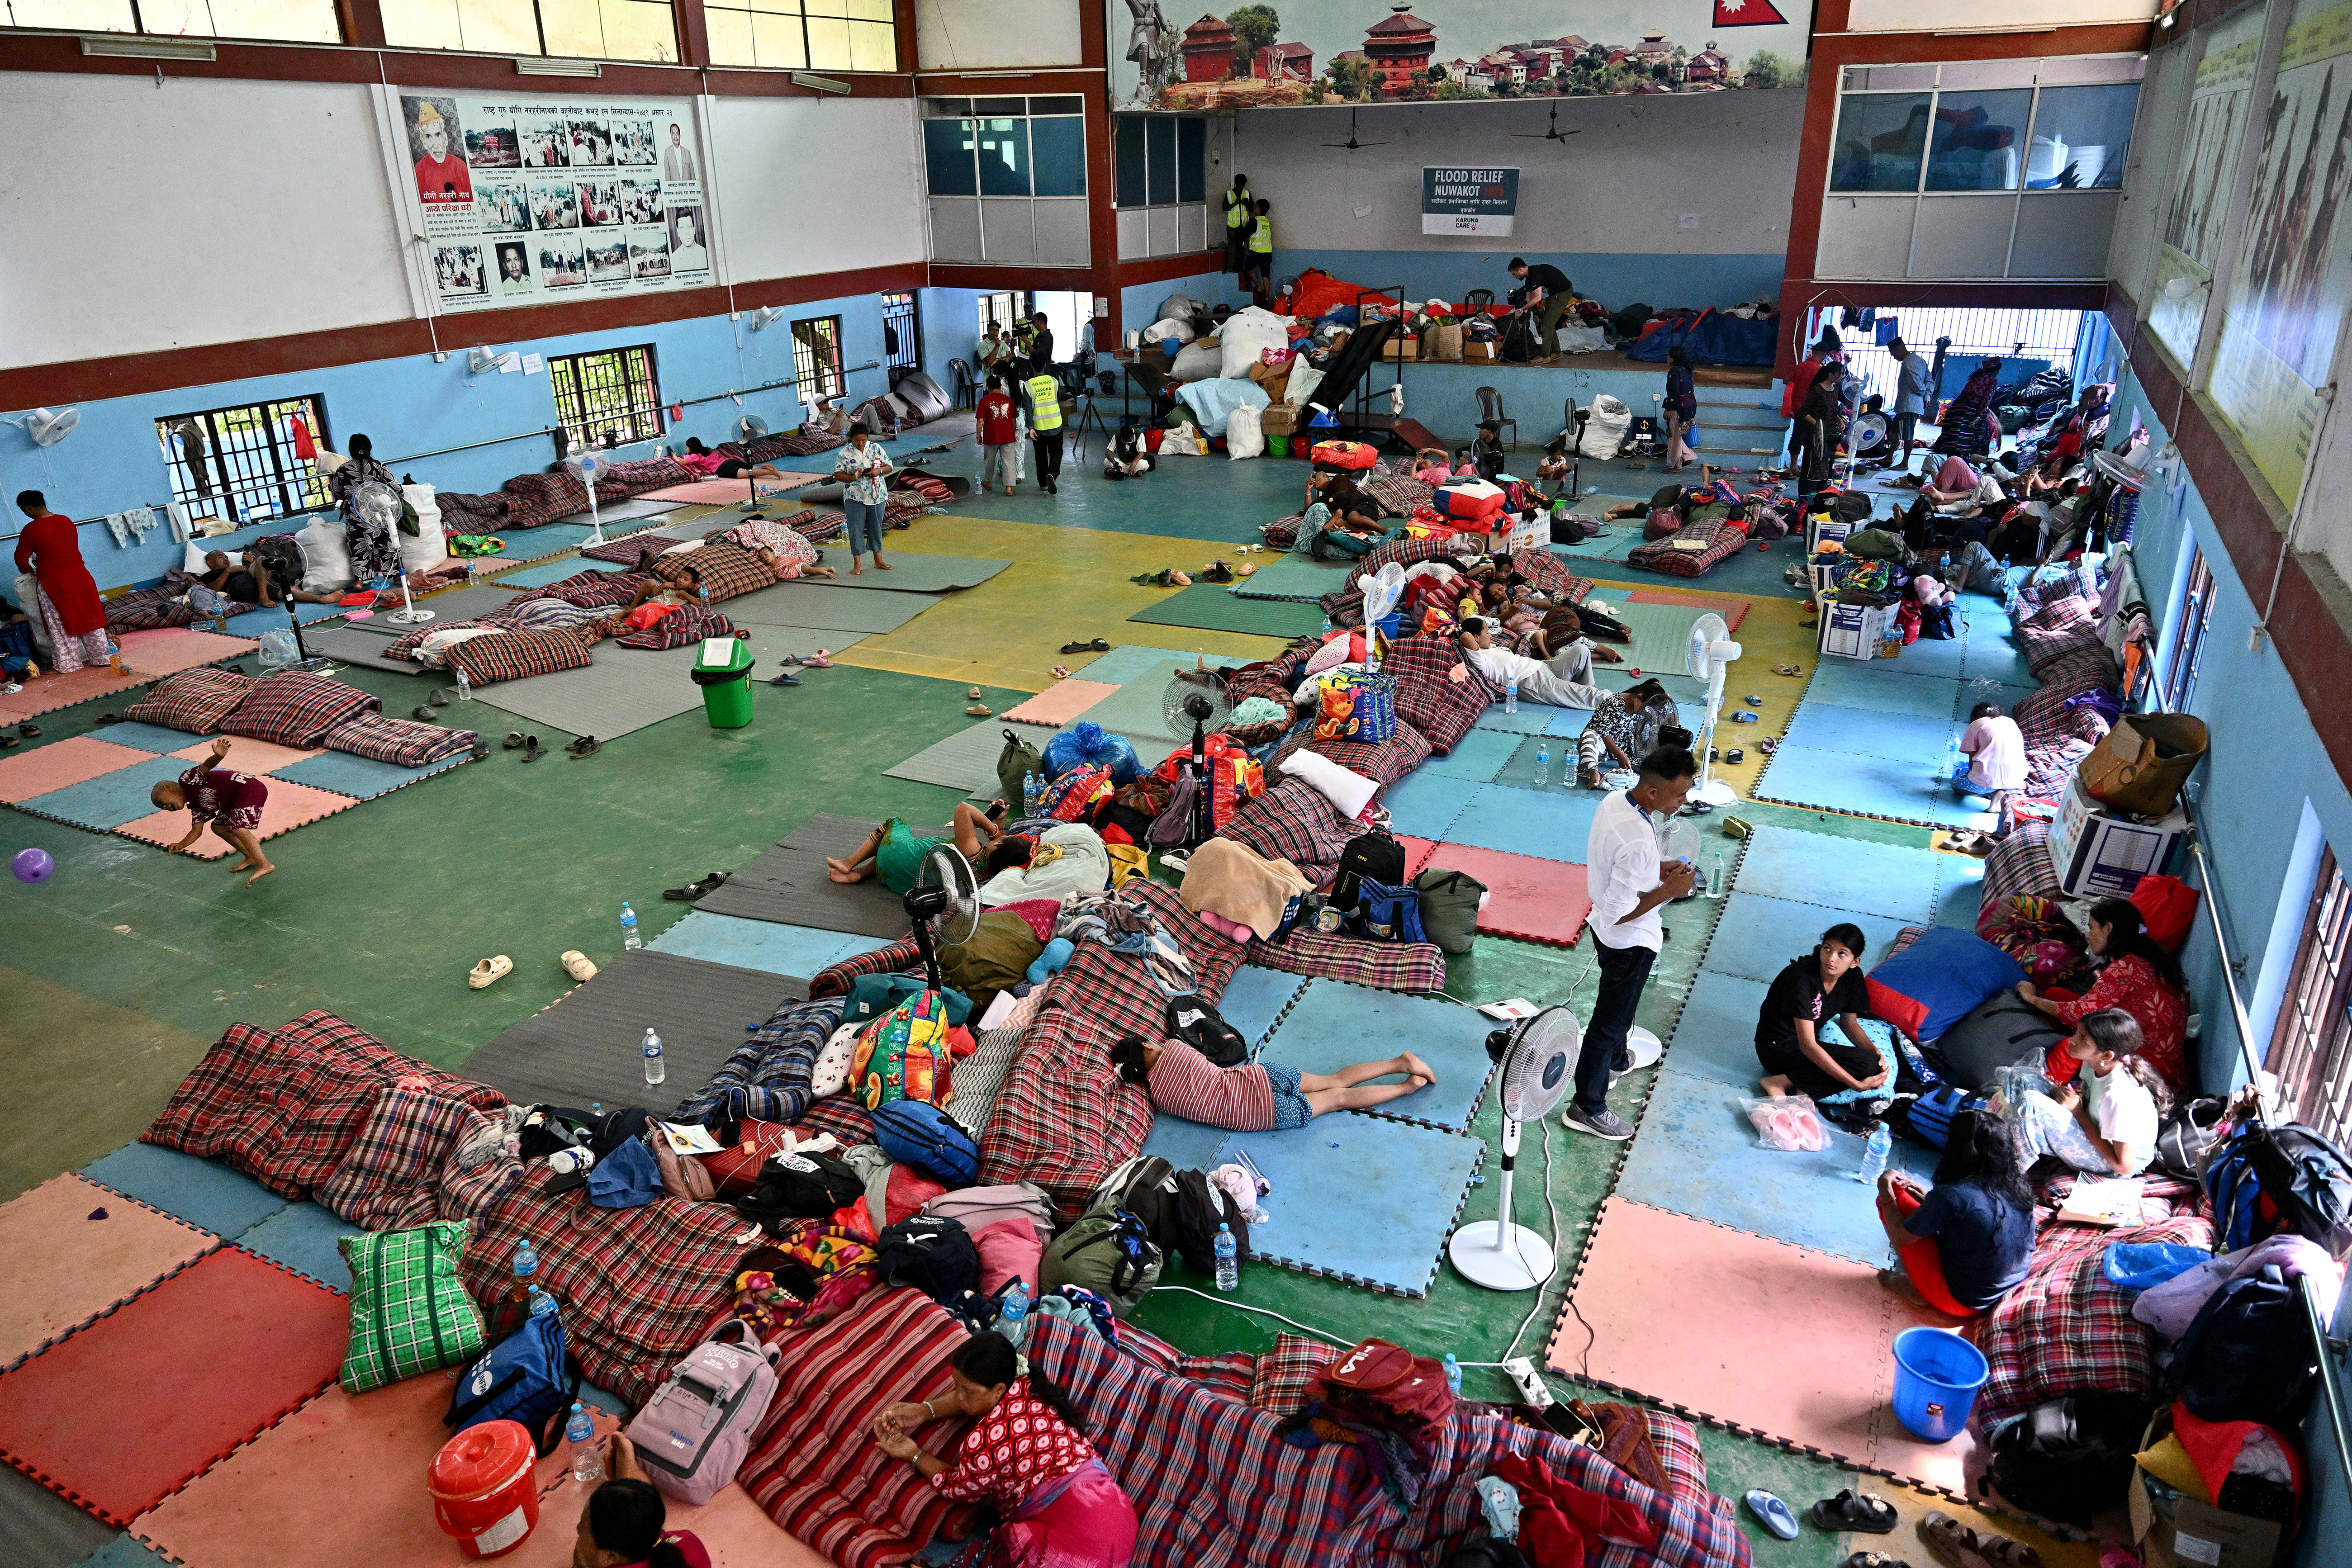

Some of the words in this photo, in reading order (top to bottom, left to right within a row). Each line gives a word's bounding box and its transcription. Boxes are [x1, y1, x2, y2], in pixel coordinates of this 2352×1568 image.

[498, 107, 507, 117] गुरु
[509, 104, 522, 114] योगि
[524, 105, 558, 116] नरहरीनाथको
[1435, 170, 1468, 182] FLOOD
[1471, 171, 1503, 183] RELIEF
[423, 190, 436, 199] योगी
[439, 190, 456, 200] नरहरी
[1435, 185, 1480, 196] NUWAKOT
[425, 204, 440, 212] आयो
[442, 204, 460, 212] परिक्षा
[2108, 889, 2130, 898] DIGNITY
[781, 1158, 809, 1172] KARUNA
[479, 1371, 487, 1394] UNFPA
[669, 1430, 695, 1446] FASHION
[671, 1439, 685, 1449] BAG
